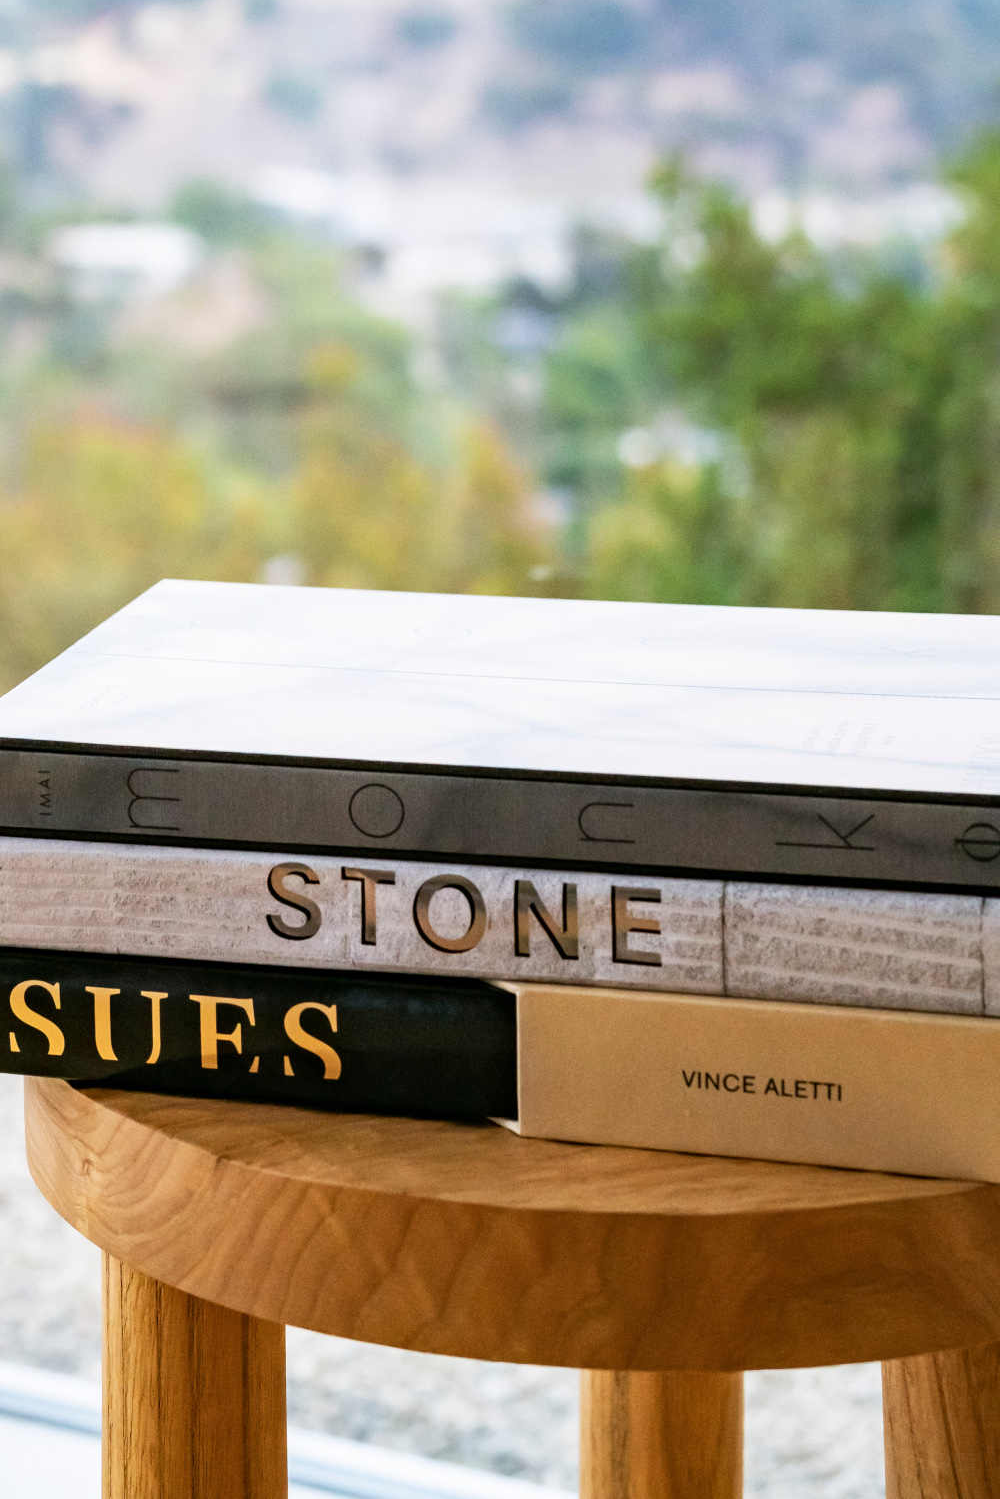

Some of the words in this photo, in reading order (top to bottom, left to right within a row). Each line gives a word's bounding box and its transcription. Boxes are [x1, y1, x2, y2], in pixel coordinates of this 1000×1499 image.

[37, 769, 52, 817] IMAI
[266, 861, 662, 967] STONE
[681, 1069, 756, 1095] VINCE
[763, 1077, 843, 1102] ALETTI
